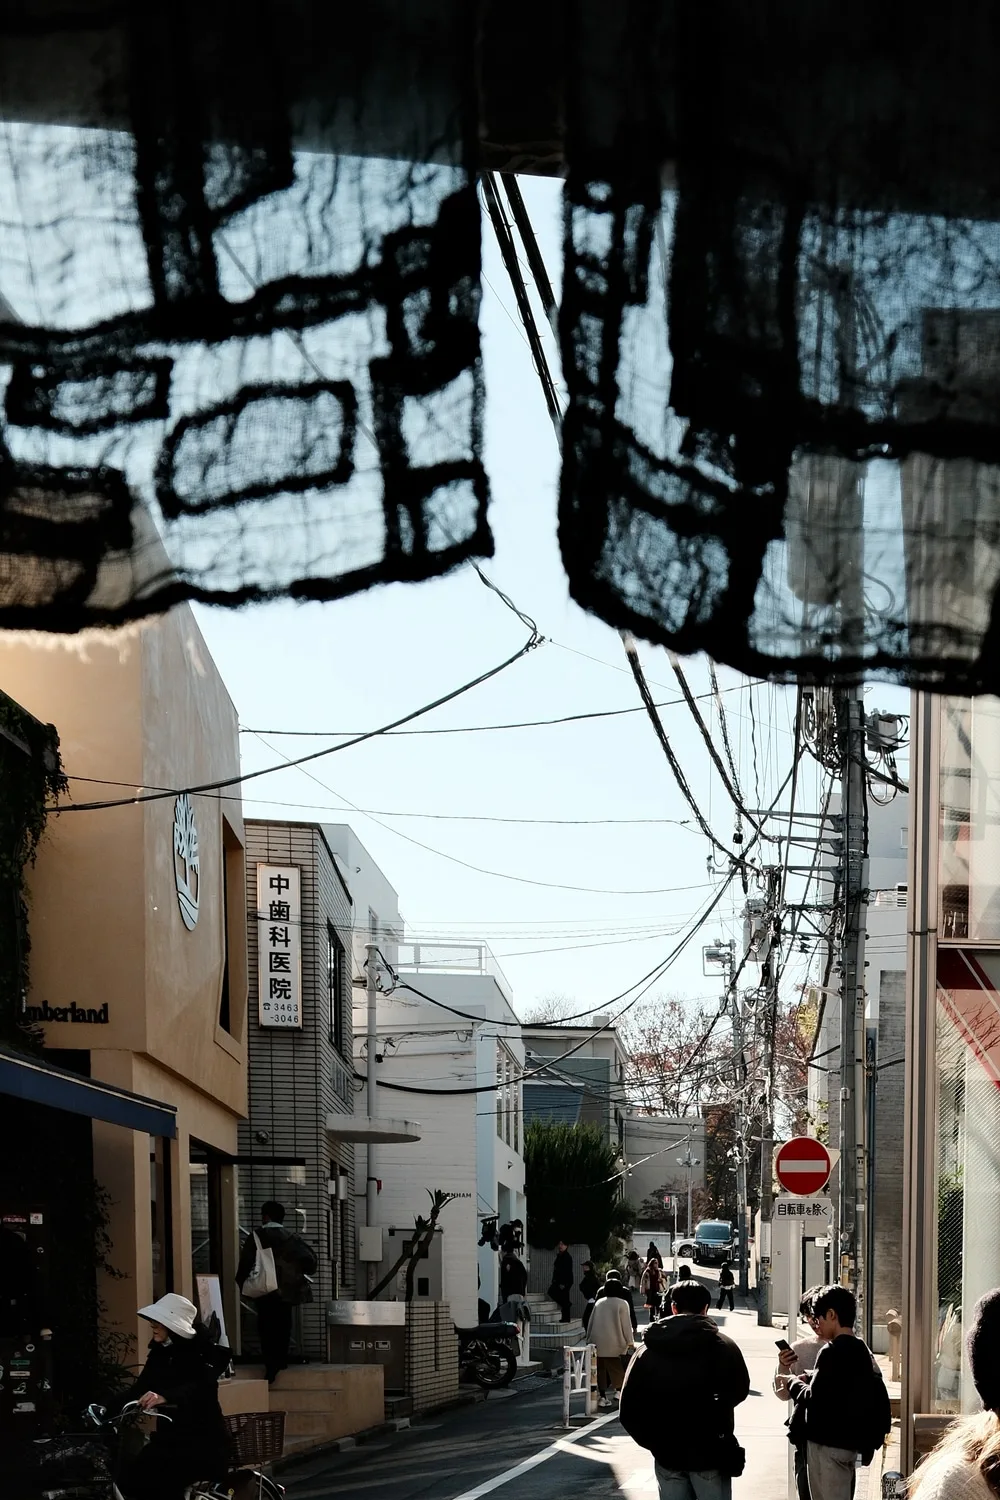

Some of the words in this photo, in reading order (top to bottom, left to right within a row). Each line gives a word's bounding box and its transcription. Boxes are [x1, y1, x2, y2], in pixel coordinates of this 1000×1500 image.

[269, 874, 292, 1000] 中歯科医院
[26, 1000, 109, 1024] mberland
[273, 1003, 298, 1012] 3463
[270, 1014, 298, 1023] -3046
[777, 1203, 828, 1216] 自転車を除く
